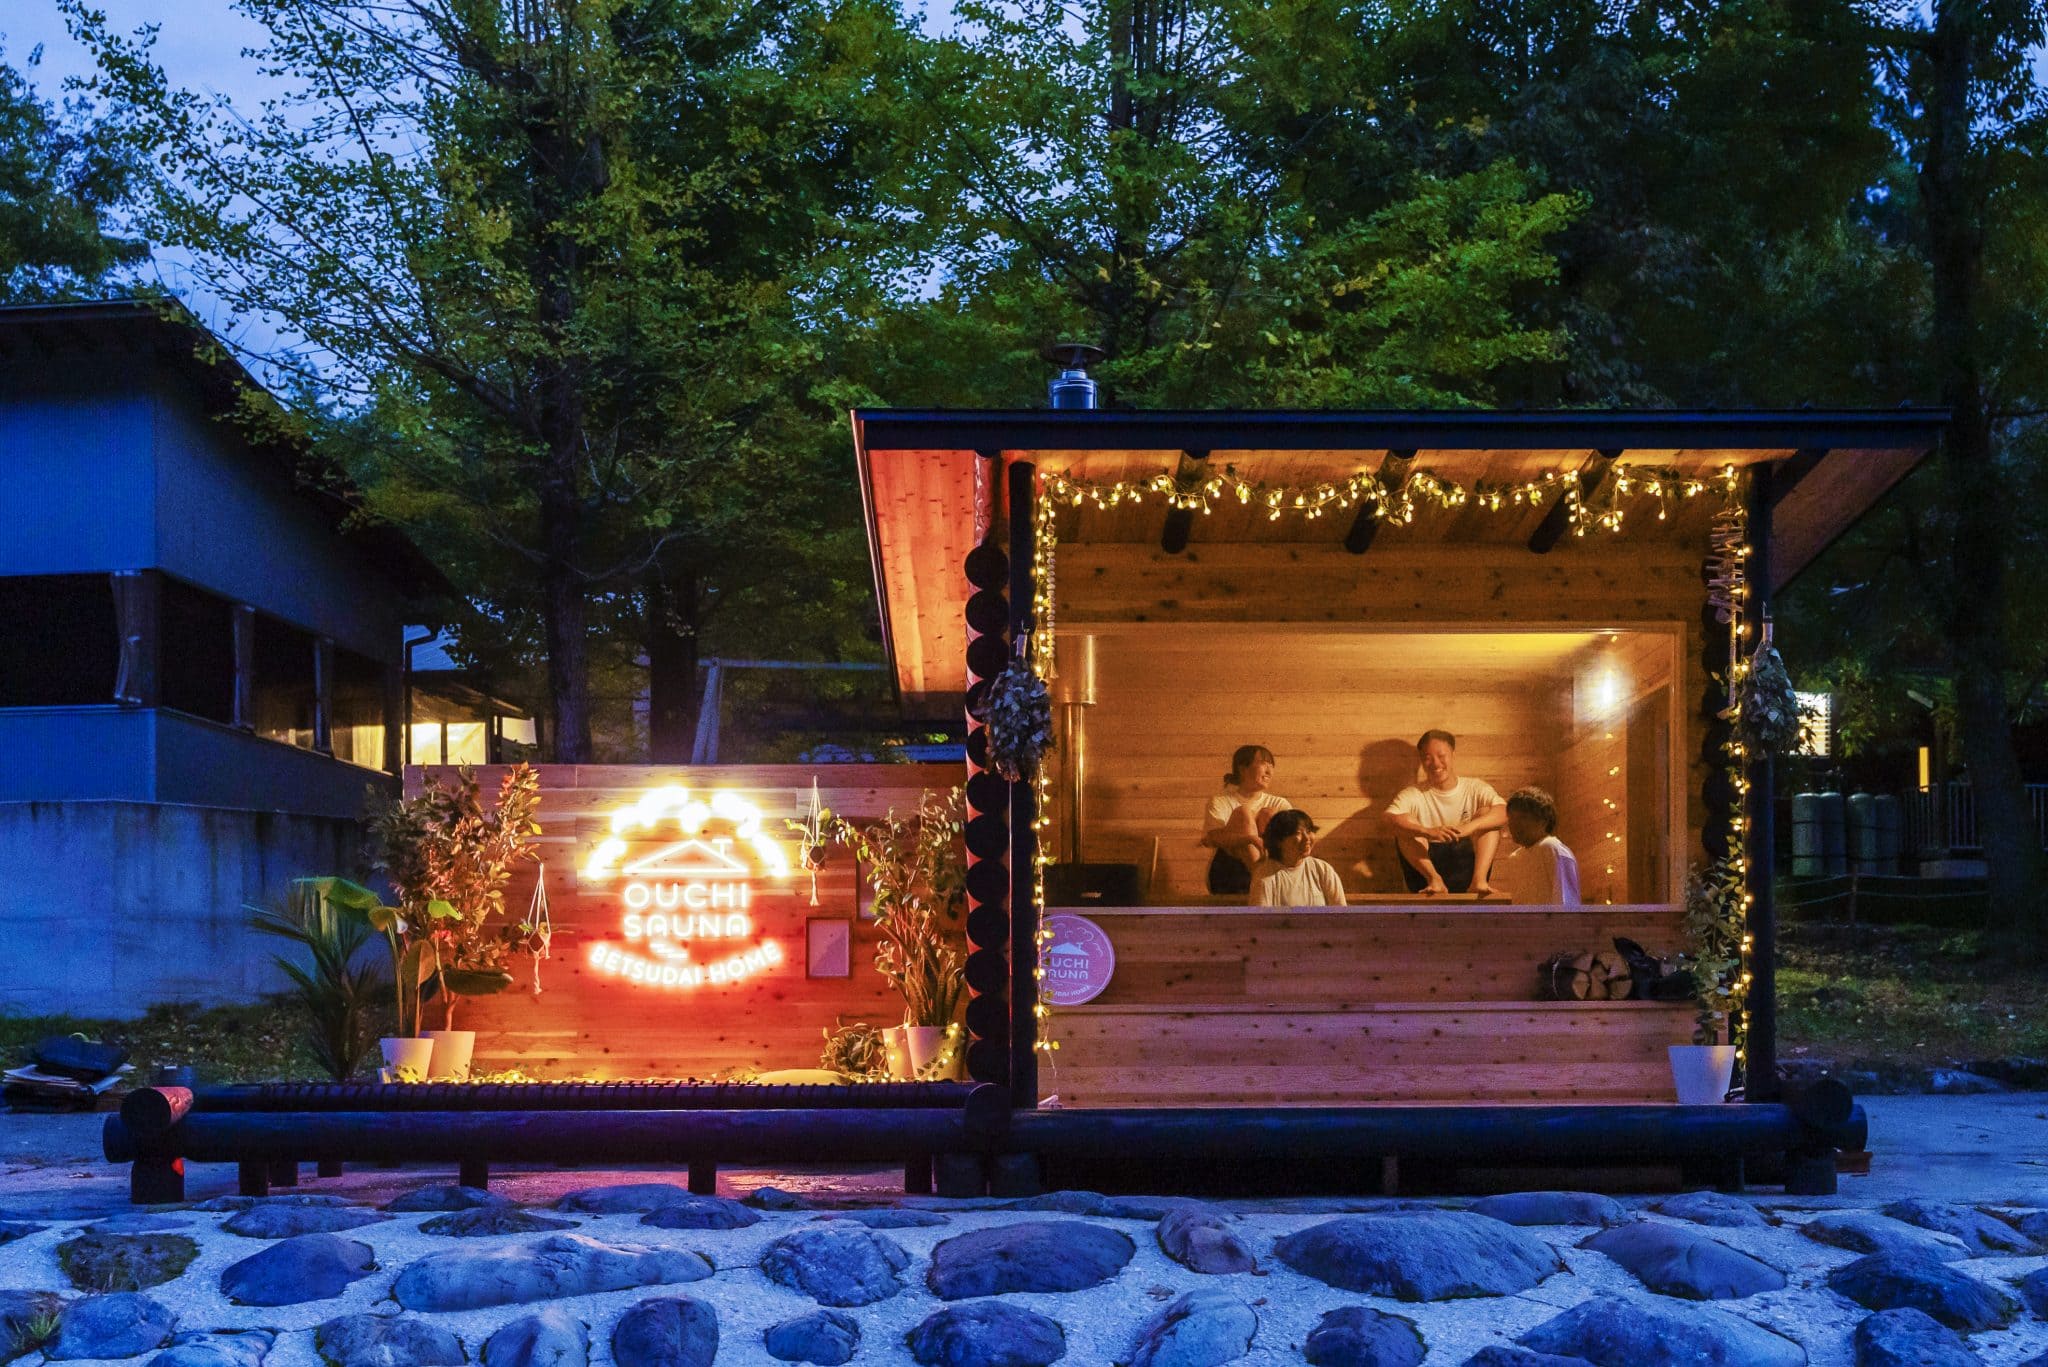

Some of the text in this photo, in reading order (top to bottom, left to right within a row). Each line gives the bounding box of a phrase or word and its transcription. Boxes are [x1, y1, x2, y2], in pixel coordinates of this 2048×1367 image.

[624, 883, 748, 908] OUCHI
[624, 913, 749, 938] SAUNA
[590, 941, 782, 985] BETSUDAI HOME
[1047, 969, 1089, 980] AUNA
